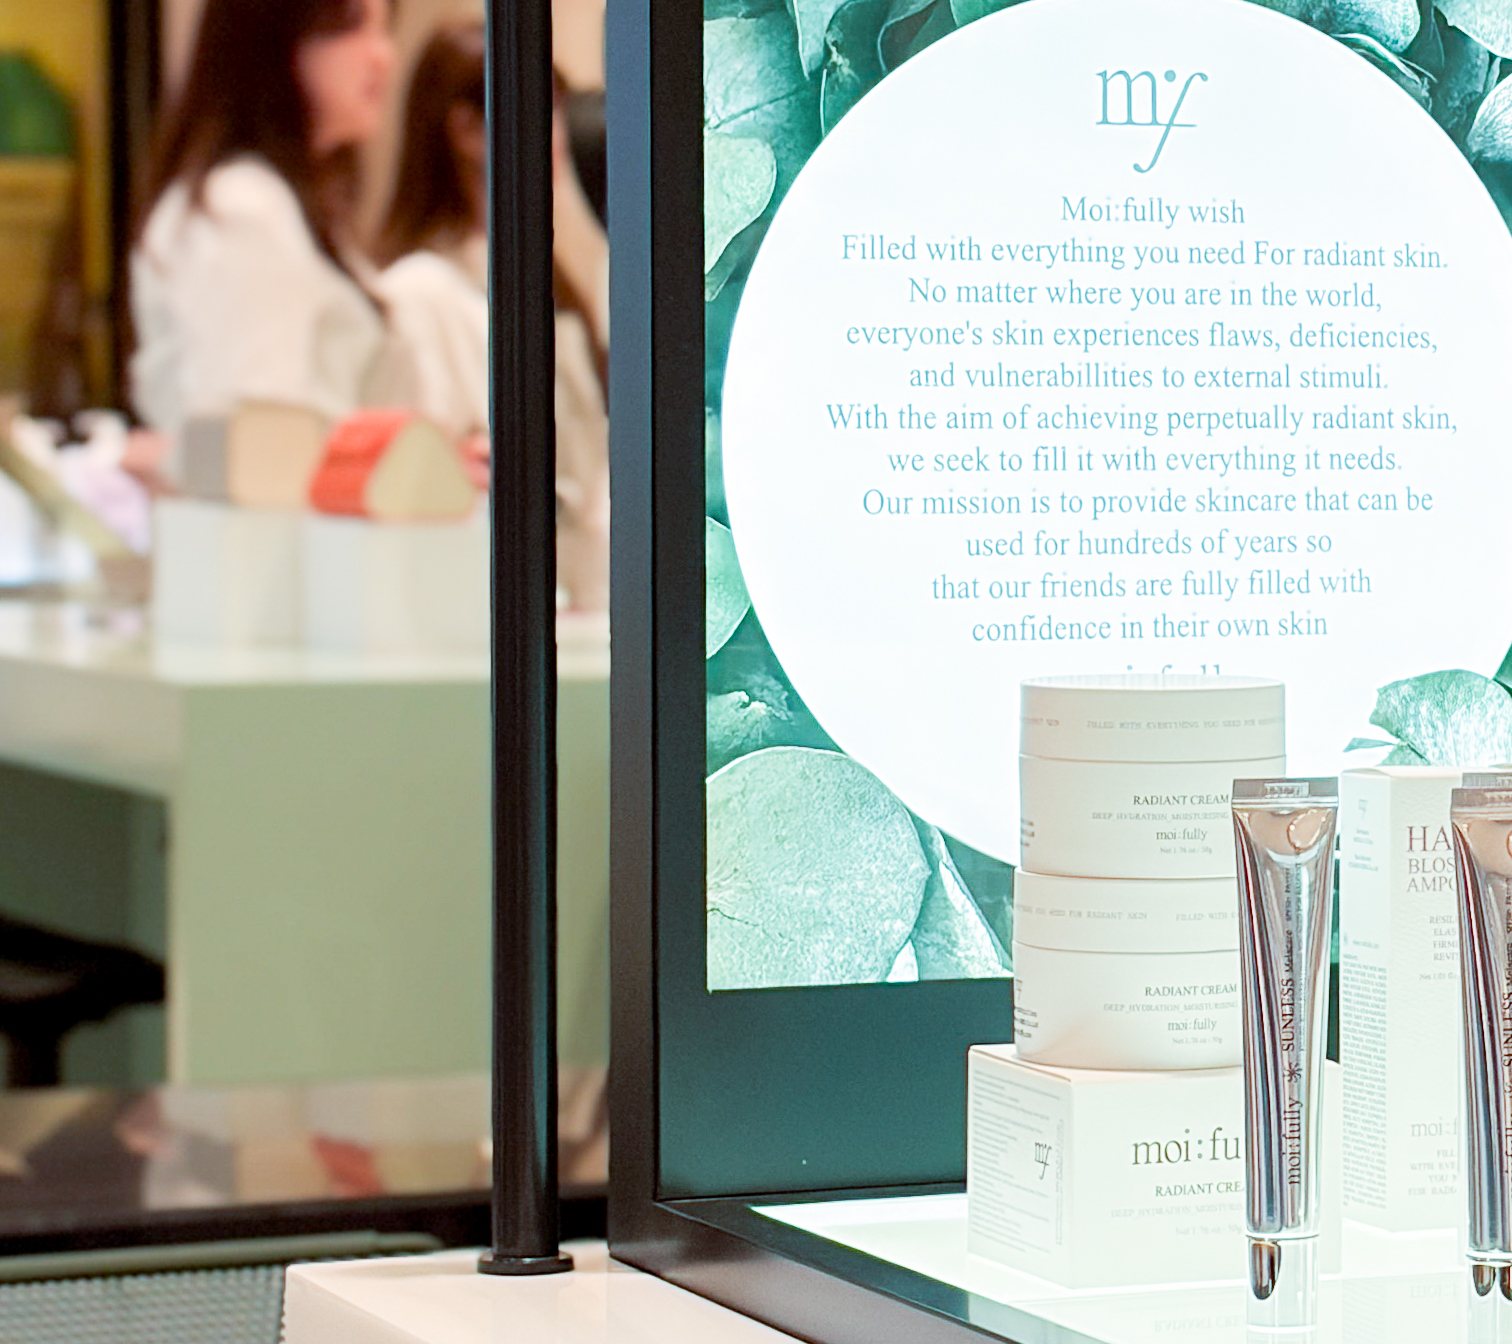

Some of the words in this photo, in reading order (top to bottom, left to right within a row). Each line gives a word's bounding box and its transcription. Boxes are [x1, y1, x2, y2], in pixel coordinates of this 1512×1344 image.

[1061, 195, 1180, 230] Moi:fully
[1187, 197, 1245, 224] wish
[841, 233, 917, 261] Filled
[925, 234, 983, 262] with
[990, 236, 1126, 271] everything
[1133, 245, 1180, 271] you
[1187, 239, 1246, 265] need
[1253, 240, 1296, 266] For
[1303, 240, 1386, 268] radiant
[1393, 242, 1449, 269] skin.
[907, 276, 947, 304] No
[956, 281, 1038, 304] matter
[1044, 278, 1122, 305] where
[1129, 286, 1176, 312] you
[1184, 287, 1222, 306] are
[1229, 280, 1253, 307] in
[1261, 280, 1298, 307] the
[1305, 281, 1382, 313] world,
[846, 319, 983, 352] everyone's
[992, 319, 1045, 346] skin
[1053, 320, 1200, 354] experiences
[1208, 321, 1281, 353] flaws,
[1289, 321, 1438, 354] deficiencies,
[909, 361, 955, 388] and
[1161, 365, 1185, 389] to
[1193, 362, 1291, 389] external
[1299, 363, 1389, 389] stimuli.
[825, 402, 889, 430] With
[897, 402, 937, 430] the
[945, 403, 994, 430] aim
[1002, 403, 1032, 430] of
[1036, 403, 1159, 437] achieving
[1166, 403, 1304, 437] perpetually
[1312, 403, 1395, 430] radiant
[1402, 404, 1458, 434] skin,
[886, 453, 925, 472] we
[933, 445, 991, 472] seek
[998, 450, 1023, 472] to
[1032, 445, 1067, 472] fill
[1077, 445, 1094, 472] it
[1101, 445, 1157, 472] with
[1165, 444, 1297, 478] everything
[1304, 445, 1321, 471] it
[1328, 444, 1402, 471] needs.
[862, 488, 914, 516] Our
[922, 488, 1022, 515] mission
[1031, 487, 1051, 514] is
[1059, 491, 1083, 514] to
[1091, 487, 1187, 521] provide
[1195, 486, 1297, 513] skincare
[1304, 485, 1350, 512] that
[1357, 493, 1398, 512] can
[1405, 485, 1434, 512] be
[965, 530, 1025, 557] used
[1033, 529, 1071, 556] for
[1078, 528, 1192, 556] hundreds
[1200, 527, 1230, 554] of
[1234, 535, 1298, 560] years
[1306, 534, 1332, 553] so
[931, 573, 981, 600] that
[988, 580, 1032, 600] our
[1040, 571, 1127, 599] friends
[1135, 578, 1173, 597] are
[1181, 569, 1239, 603] fully
[1248, 568, 1312, 595] filled
[1319, 567, 1372, 594] with
[971, 614, 1112, 642] confidence
[1120, 612, 1144, 639] in
[1152, 612, 1210, 639] their
[1217, 618, 1270, 638] own
[1278, 609, 1328, 637] skin
[1132, 794, 1189, 806] RADIANT
[1190, 793, 1229, 805] CREAM
[1155, 827, 1208, 842] moi:fully
[1406, 824, 1452, 853] HA
[1407, 857, 1455, 874] BLOS
[1144, 985, 1199, 997] RADIANT
[1200, 983, 1238, 995] CREAM
[1167, 1017, 1218, 1032] moi:fully
[1280, 978, 1295, 1052] SUNLESS
[1281, 1097, 1303, 1186] moi:fully
[1410, 1116, 1458, 1138] moi:f
[1131, 1126, 1242, 1166] moi:fu
[1155, 1183, 1213, 1198] RADIANT
[1216, 1181, 1245, 1194] CRE
